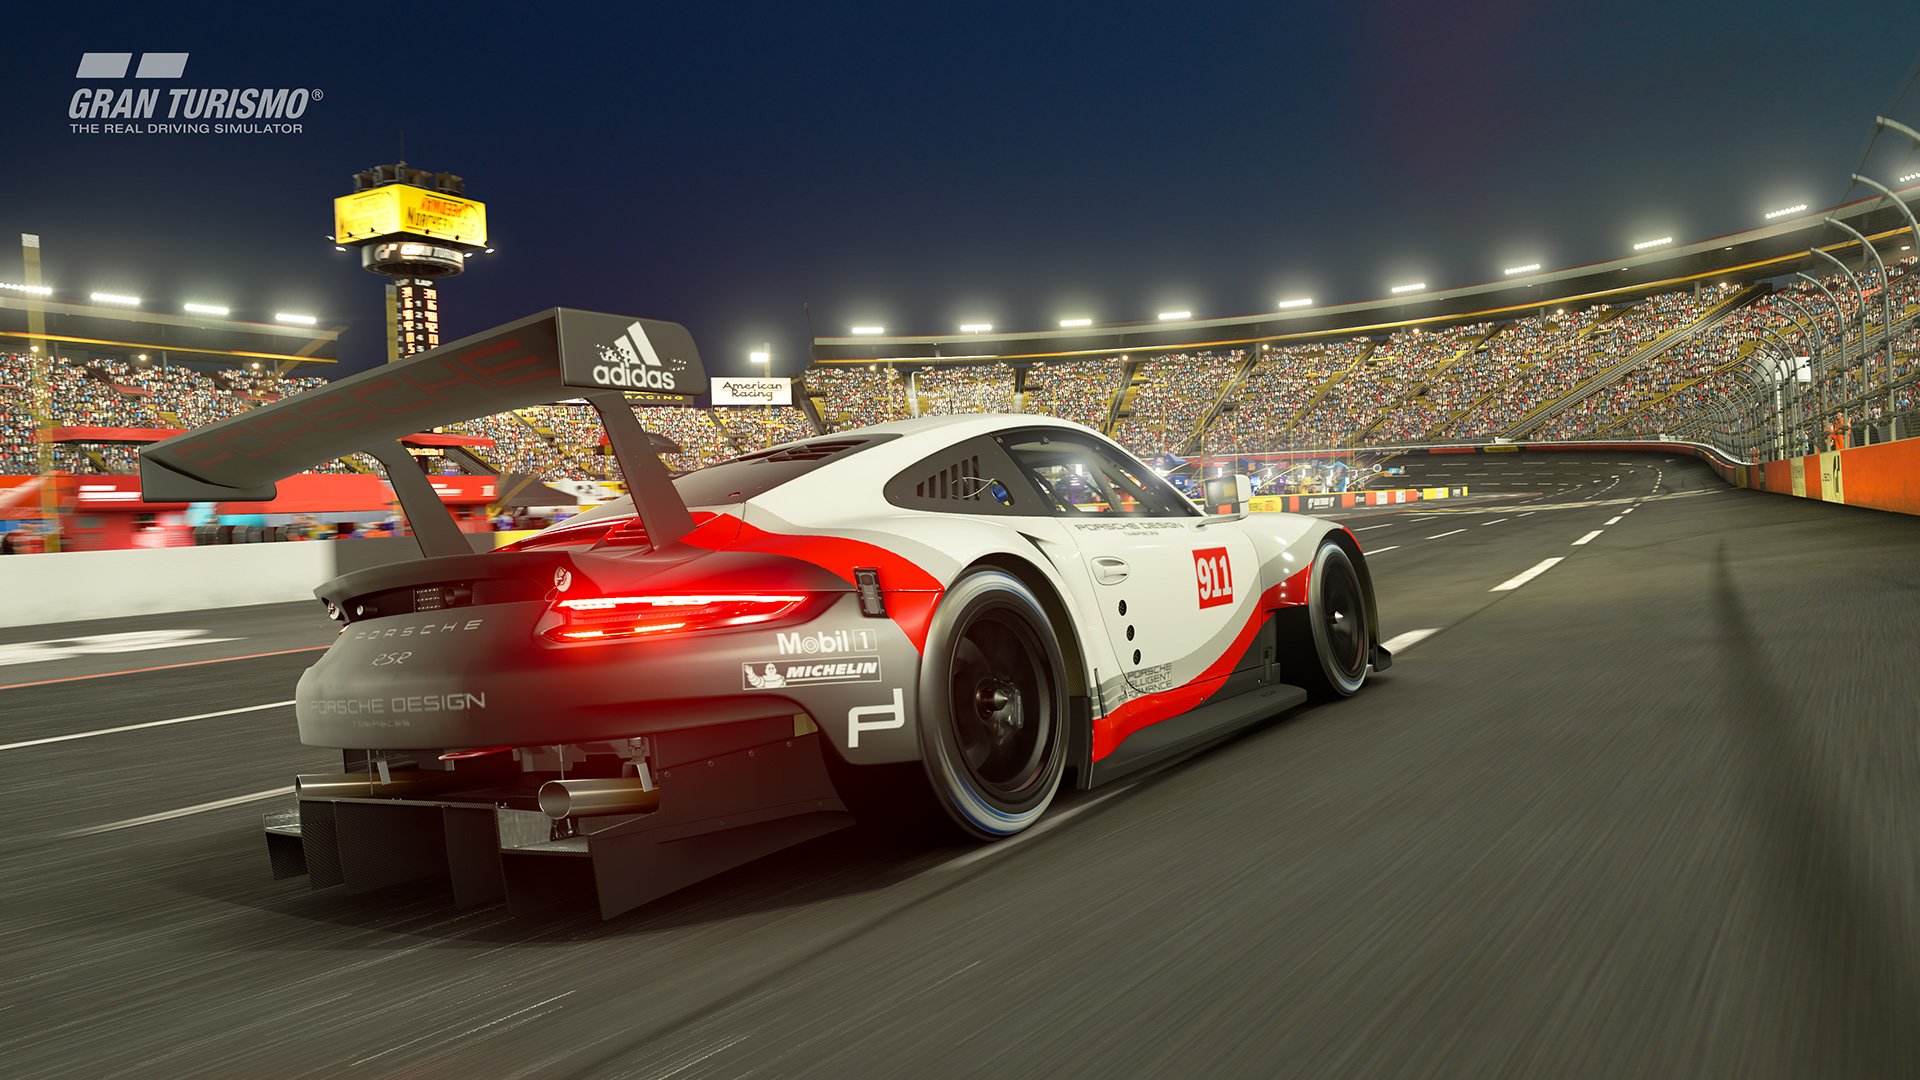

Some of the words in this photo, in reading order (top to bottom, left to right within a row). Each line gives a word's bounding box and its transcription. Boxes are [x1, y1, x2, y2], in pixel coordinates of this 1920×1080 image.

[593, 363, 676, 390] adidas
[722, 381, 783, 391] American
[731, 389, 774, 402] Racing
[1196, 555, 1233, 600] 911
[354, 619, 483, 640] PORSCHE
[776, 630, 850, 655] Mobil
[370, 651, 413, 666] RSR
[785, 662, 878, 679] MICHELIN
[1126, 662, 1172, 680] PORSCHE
[311, 698, 385, 715] PORSCHE
[390, 692, 486, 713] DESIGN
